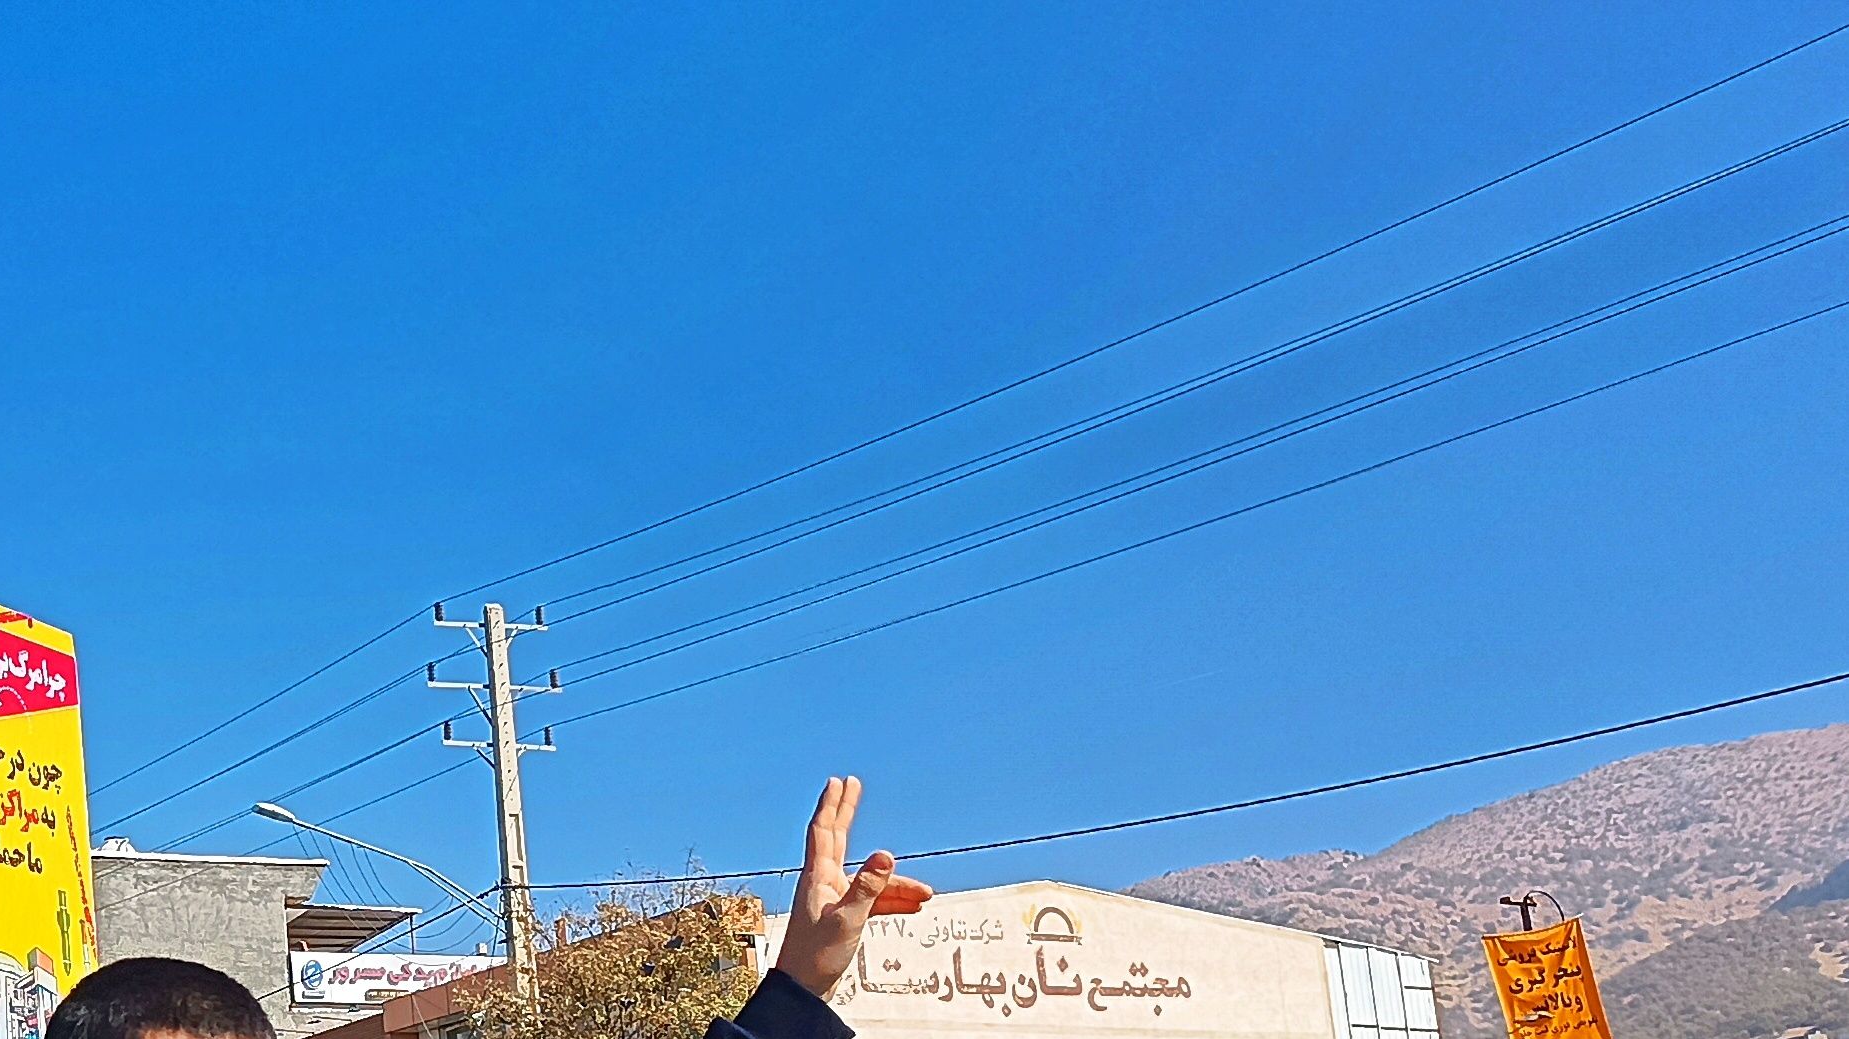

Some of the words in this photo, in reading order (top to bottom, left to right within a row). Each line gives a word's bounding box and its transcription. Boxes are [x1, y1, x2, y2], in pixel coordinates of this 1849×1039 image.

[9, 650, 44, 691] مرگ
[6, 750, 26, 780] در
[28, 761, 64, 795] چون
[40, 804, 56, 838] به
[26, 841, 43, 875] ما
[919, 916, 968, 949] تعاونی
[969, 918, 1004, 945] شرکت
[1010, 946, 1084, 1009] نان
[1086, 961, 1193, 1017] مجتمع
